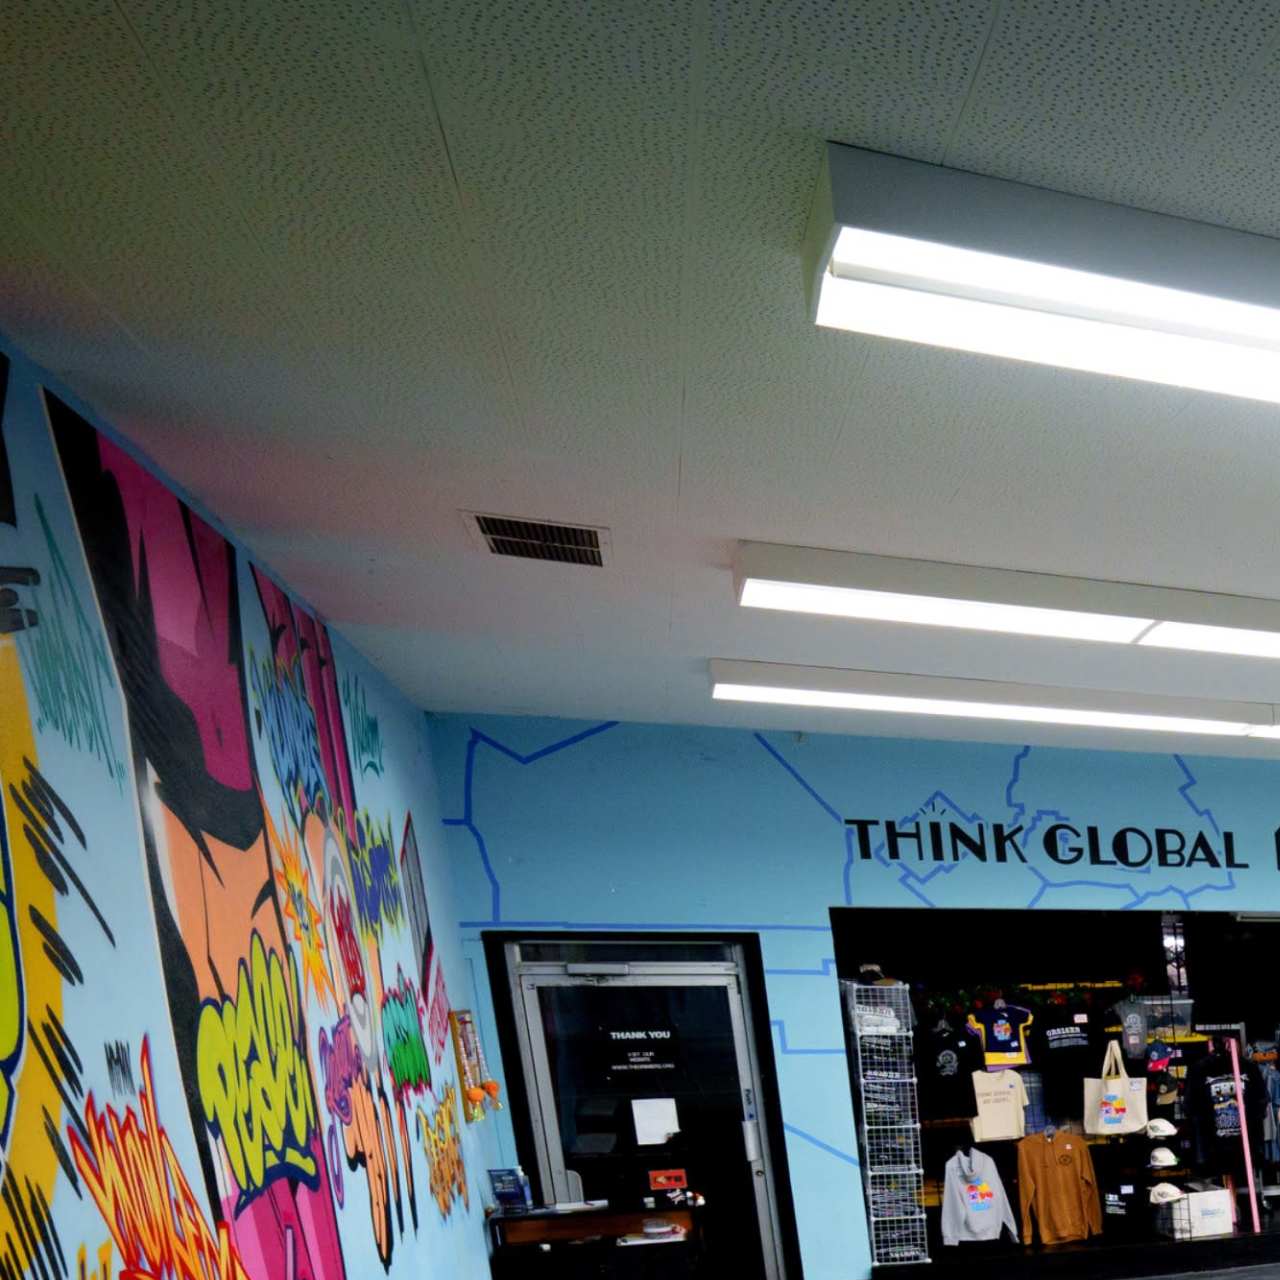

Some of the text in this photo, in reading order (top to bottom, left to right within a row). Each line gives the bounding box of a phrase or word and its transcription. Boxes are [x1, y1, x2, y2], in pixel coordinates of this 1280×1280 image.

[844, 819, 1028, 863] THINK
[1043, 823, 1249, 869] GLOBAL
[609, 1030, 671, 1040] THANK YOU
